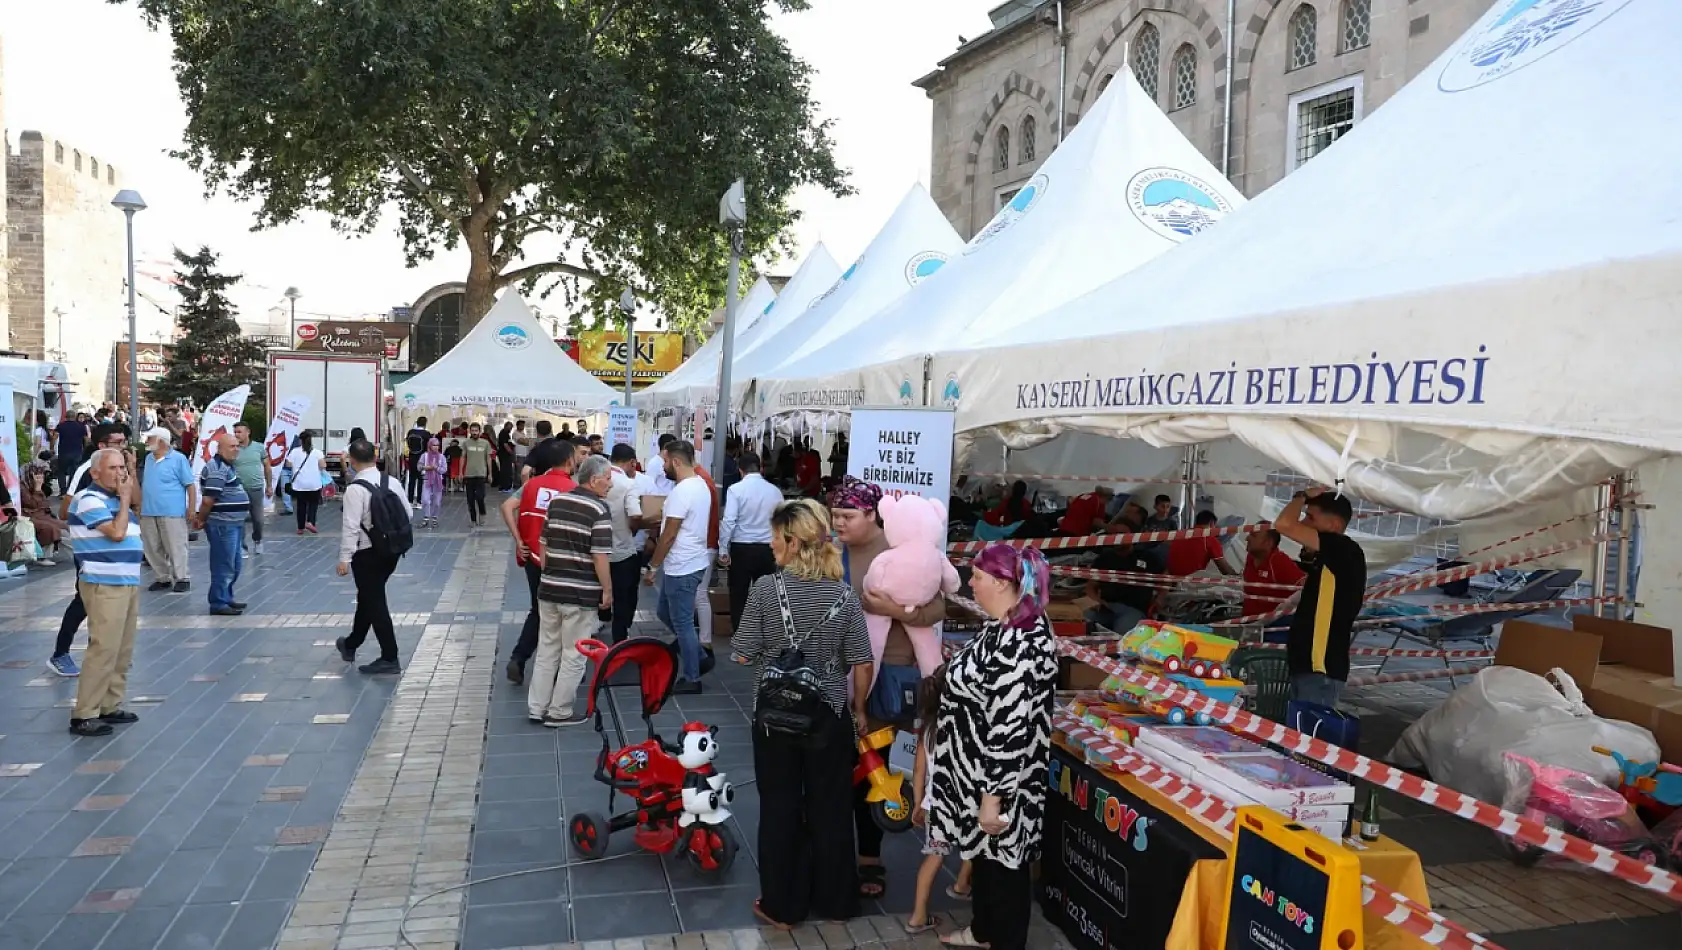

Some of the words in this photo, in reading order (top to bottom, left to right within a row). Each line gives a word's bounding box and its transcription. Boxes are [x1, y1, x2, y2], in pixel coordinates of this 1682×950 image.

[606, 335, 654, 365] zeki
[1015, 372, 1091, 410] KAYSERİ
[1092, 359, 1239, 409] MELİKGAZİ
[1245, 344, 1491, 406] BELEDİYESİ
[878, 430, 921, 446] HALLEY
[878, 449, 893, 463] VE
[896, 446, 915, 465] BİZ
[863, 464, 934, 487] BİRBİRİMİZE
[1049, 759, 1089, 811] CAN
[1094, 787, 1149, 852] TOYS
[1097, 864, 1124, 903] Vitrini
[1241, 874, 1275, 907] CAN
[1277, 895, 1314, 934] TOYS
